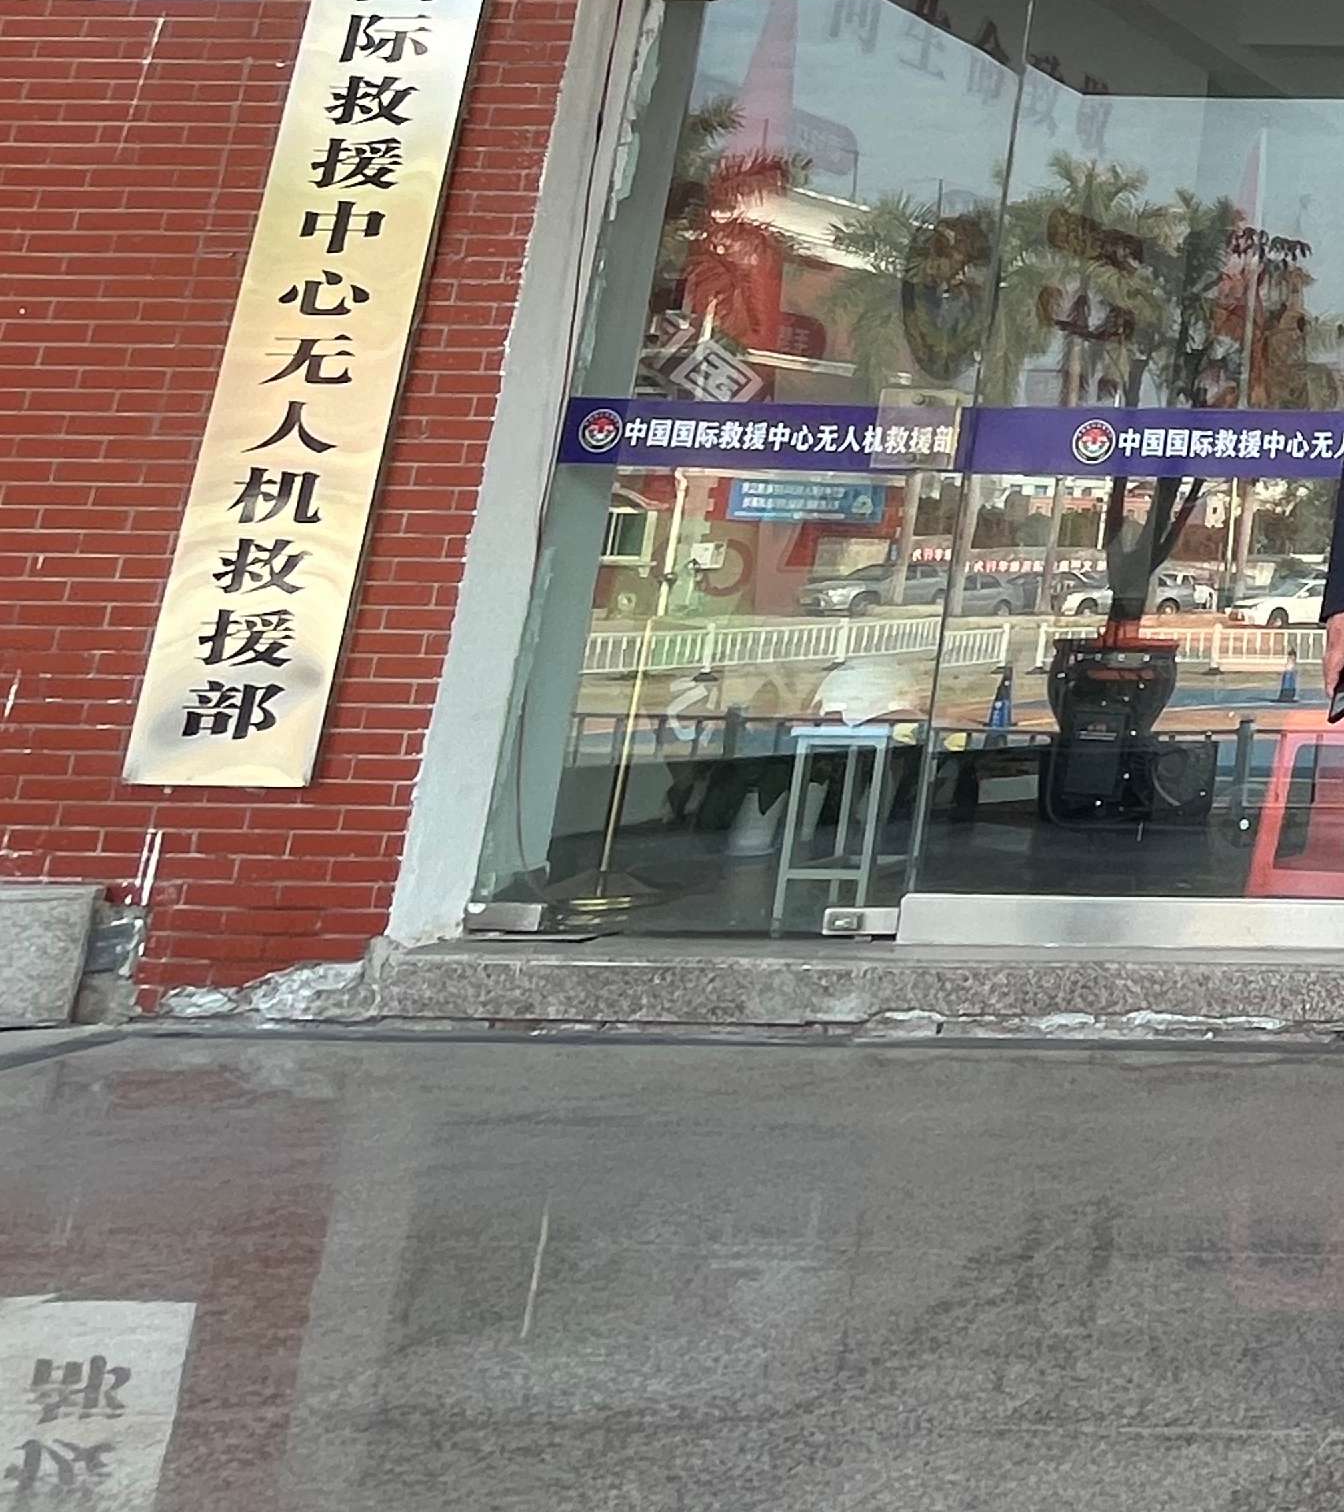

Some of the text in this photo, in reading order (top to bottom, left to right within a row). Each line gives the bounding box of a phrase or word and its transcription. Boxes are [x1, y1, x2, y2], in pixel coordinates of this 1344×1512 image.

[624, 418, 960, 455] 中国国际救援中心无人机救援部
